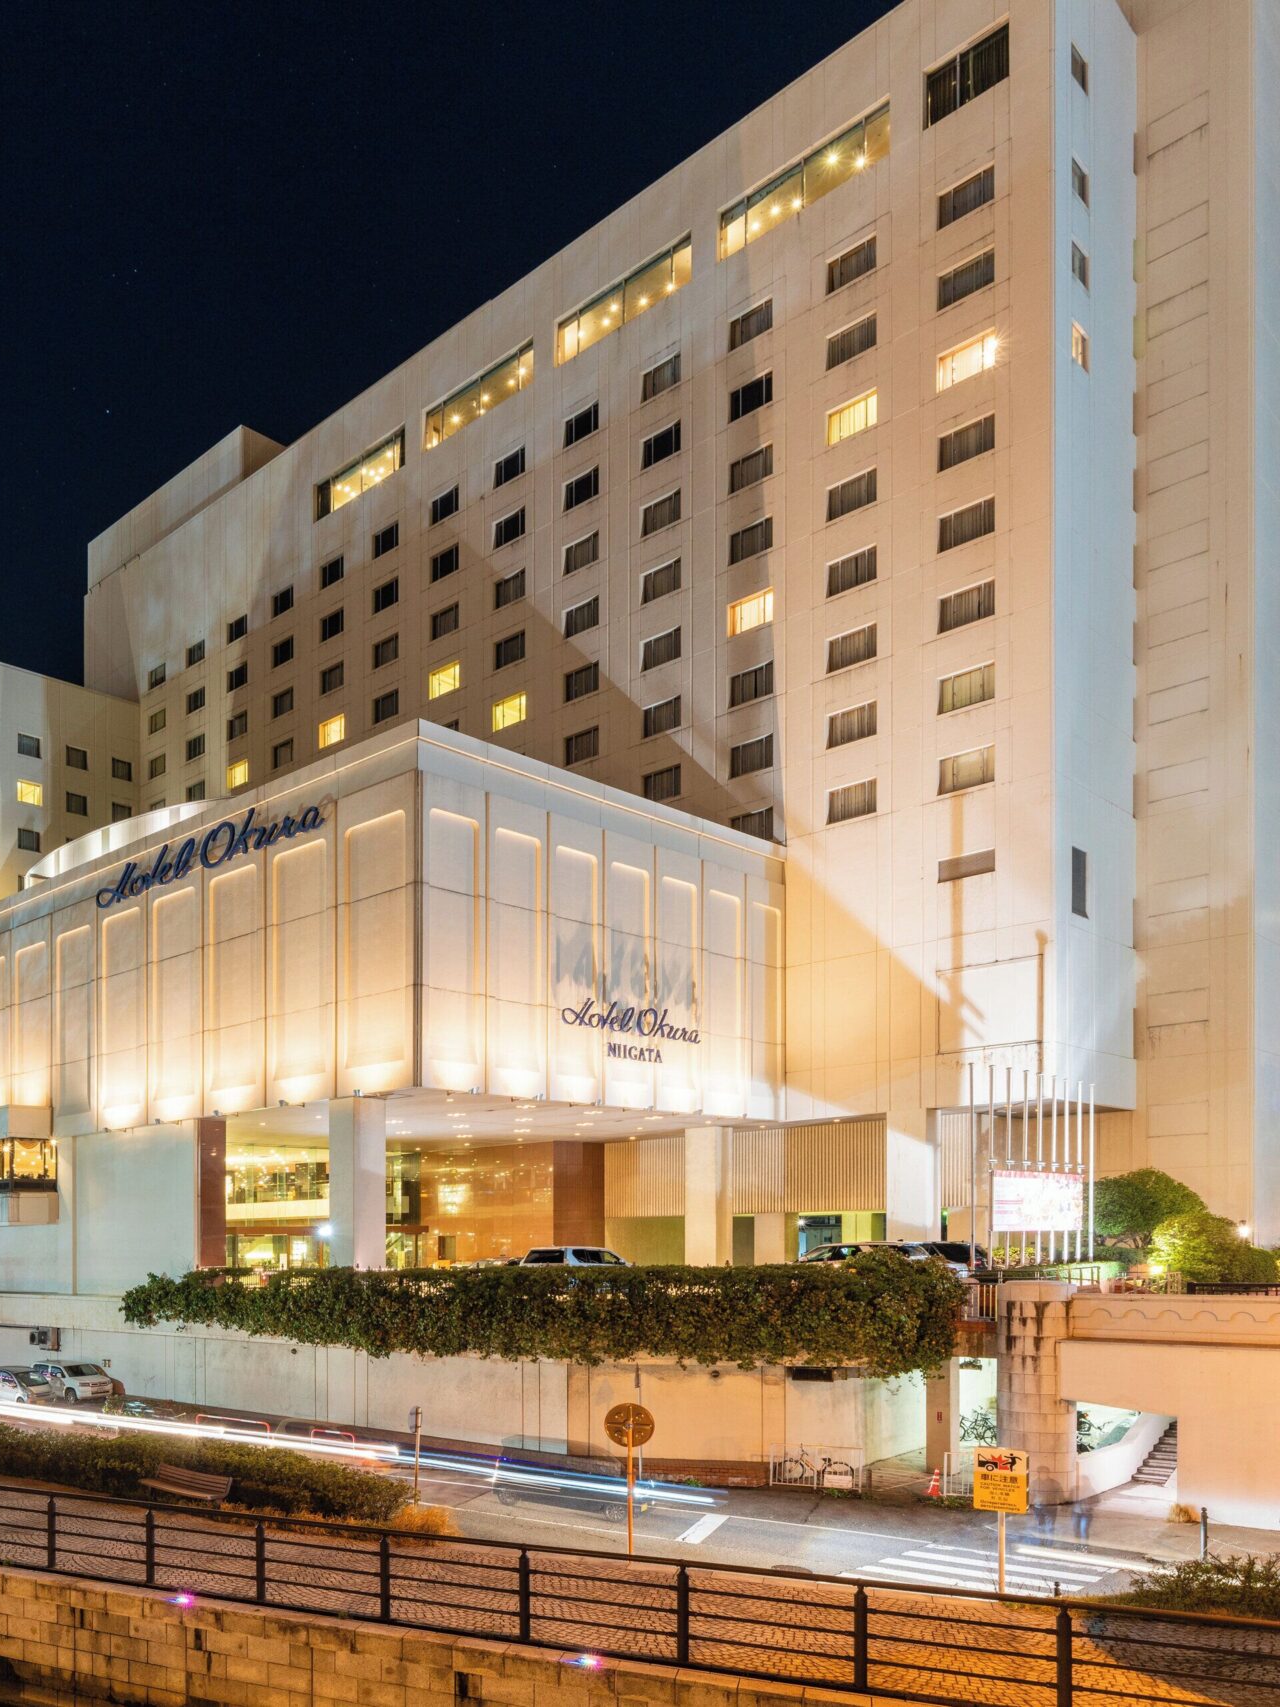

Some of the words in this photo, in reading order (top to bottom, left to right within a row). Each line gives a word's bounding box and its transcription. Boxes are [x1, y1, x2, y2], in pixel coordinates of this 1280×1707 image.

[96, 837, 196, 908] Hotel
[200, 805, 325, 869] Okura
[561, 997, 635, 1033] Hotel
[636, 1008, 701, 1044] Okura
[607, 1042, 663, 1064] NIIGATA
